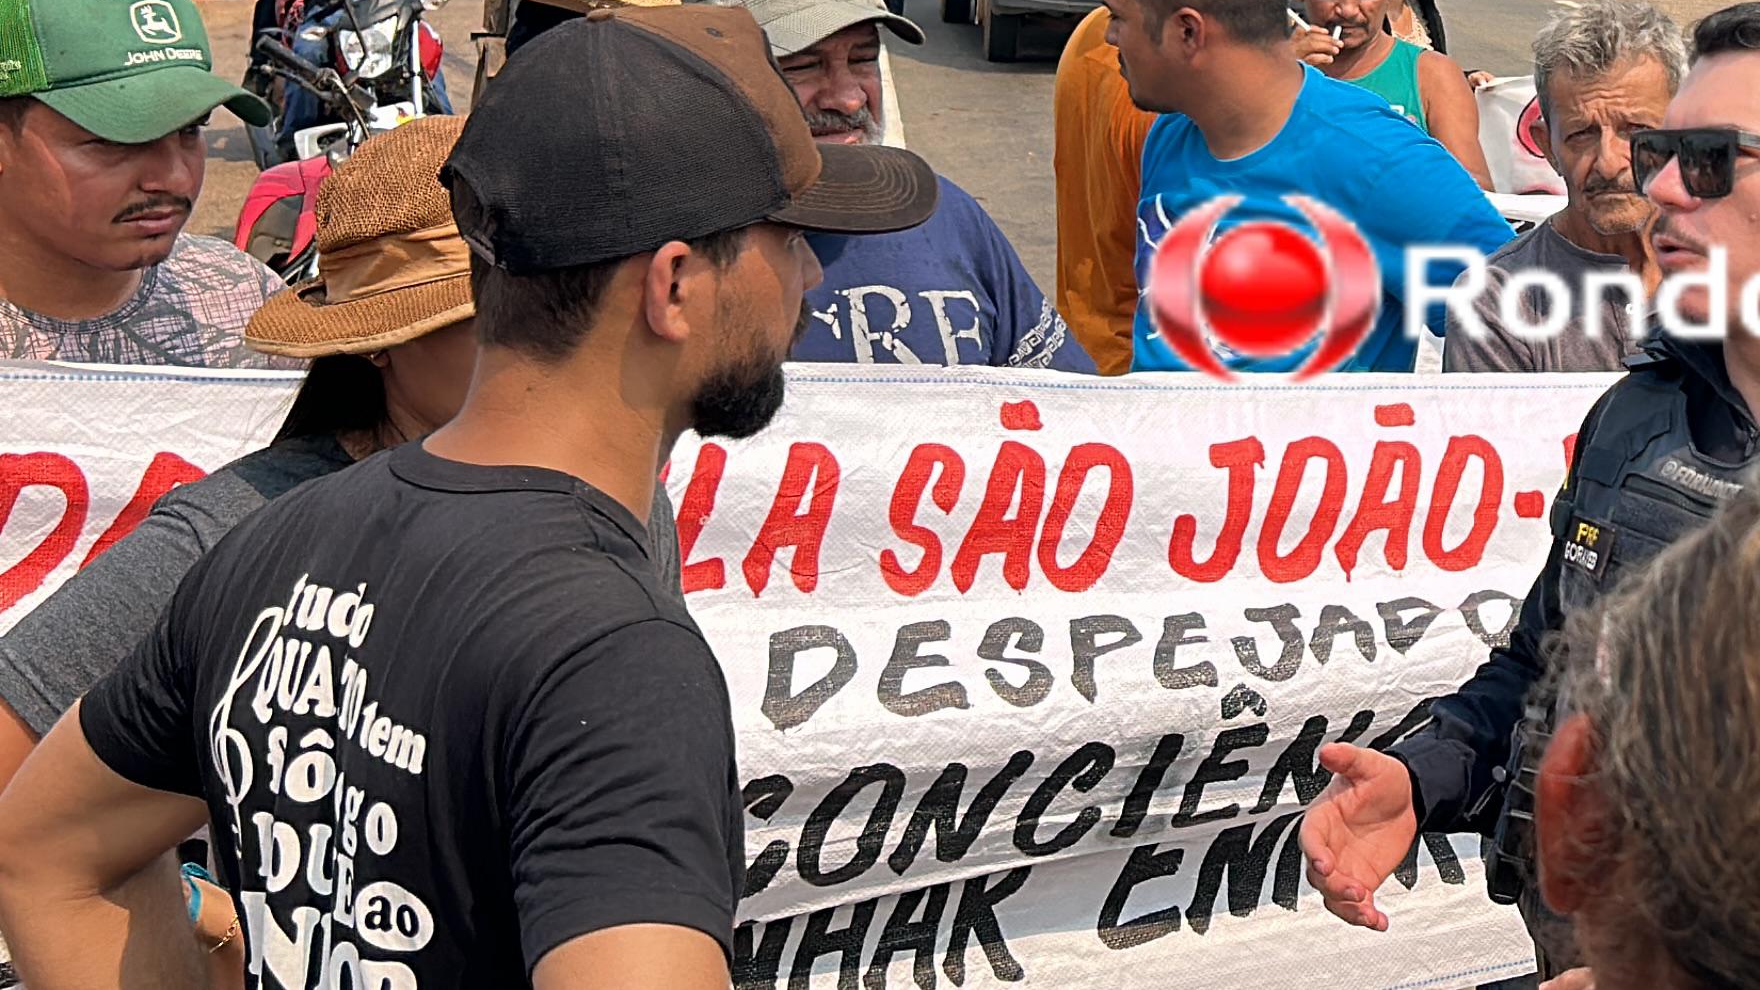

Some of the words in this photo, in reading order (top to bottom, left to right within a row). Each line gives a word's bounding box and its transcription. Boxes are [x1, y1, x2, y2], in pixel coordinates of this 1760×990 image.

[879, 399, 1135, 597] SÃO
[283, 573, 375, 649] tudo
[359, 701, 427, 775] tem
[738, 682, 1437, 901] CONCIÊN
[364, 895, 420, 939] ao
